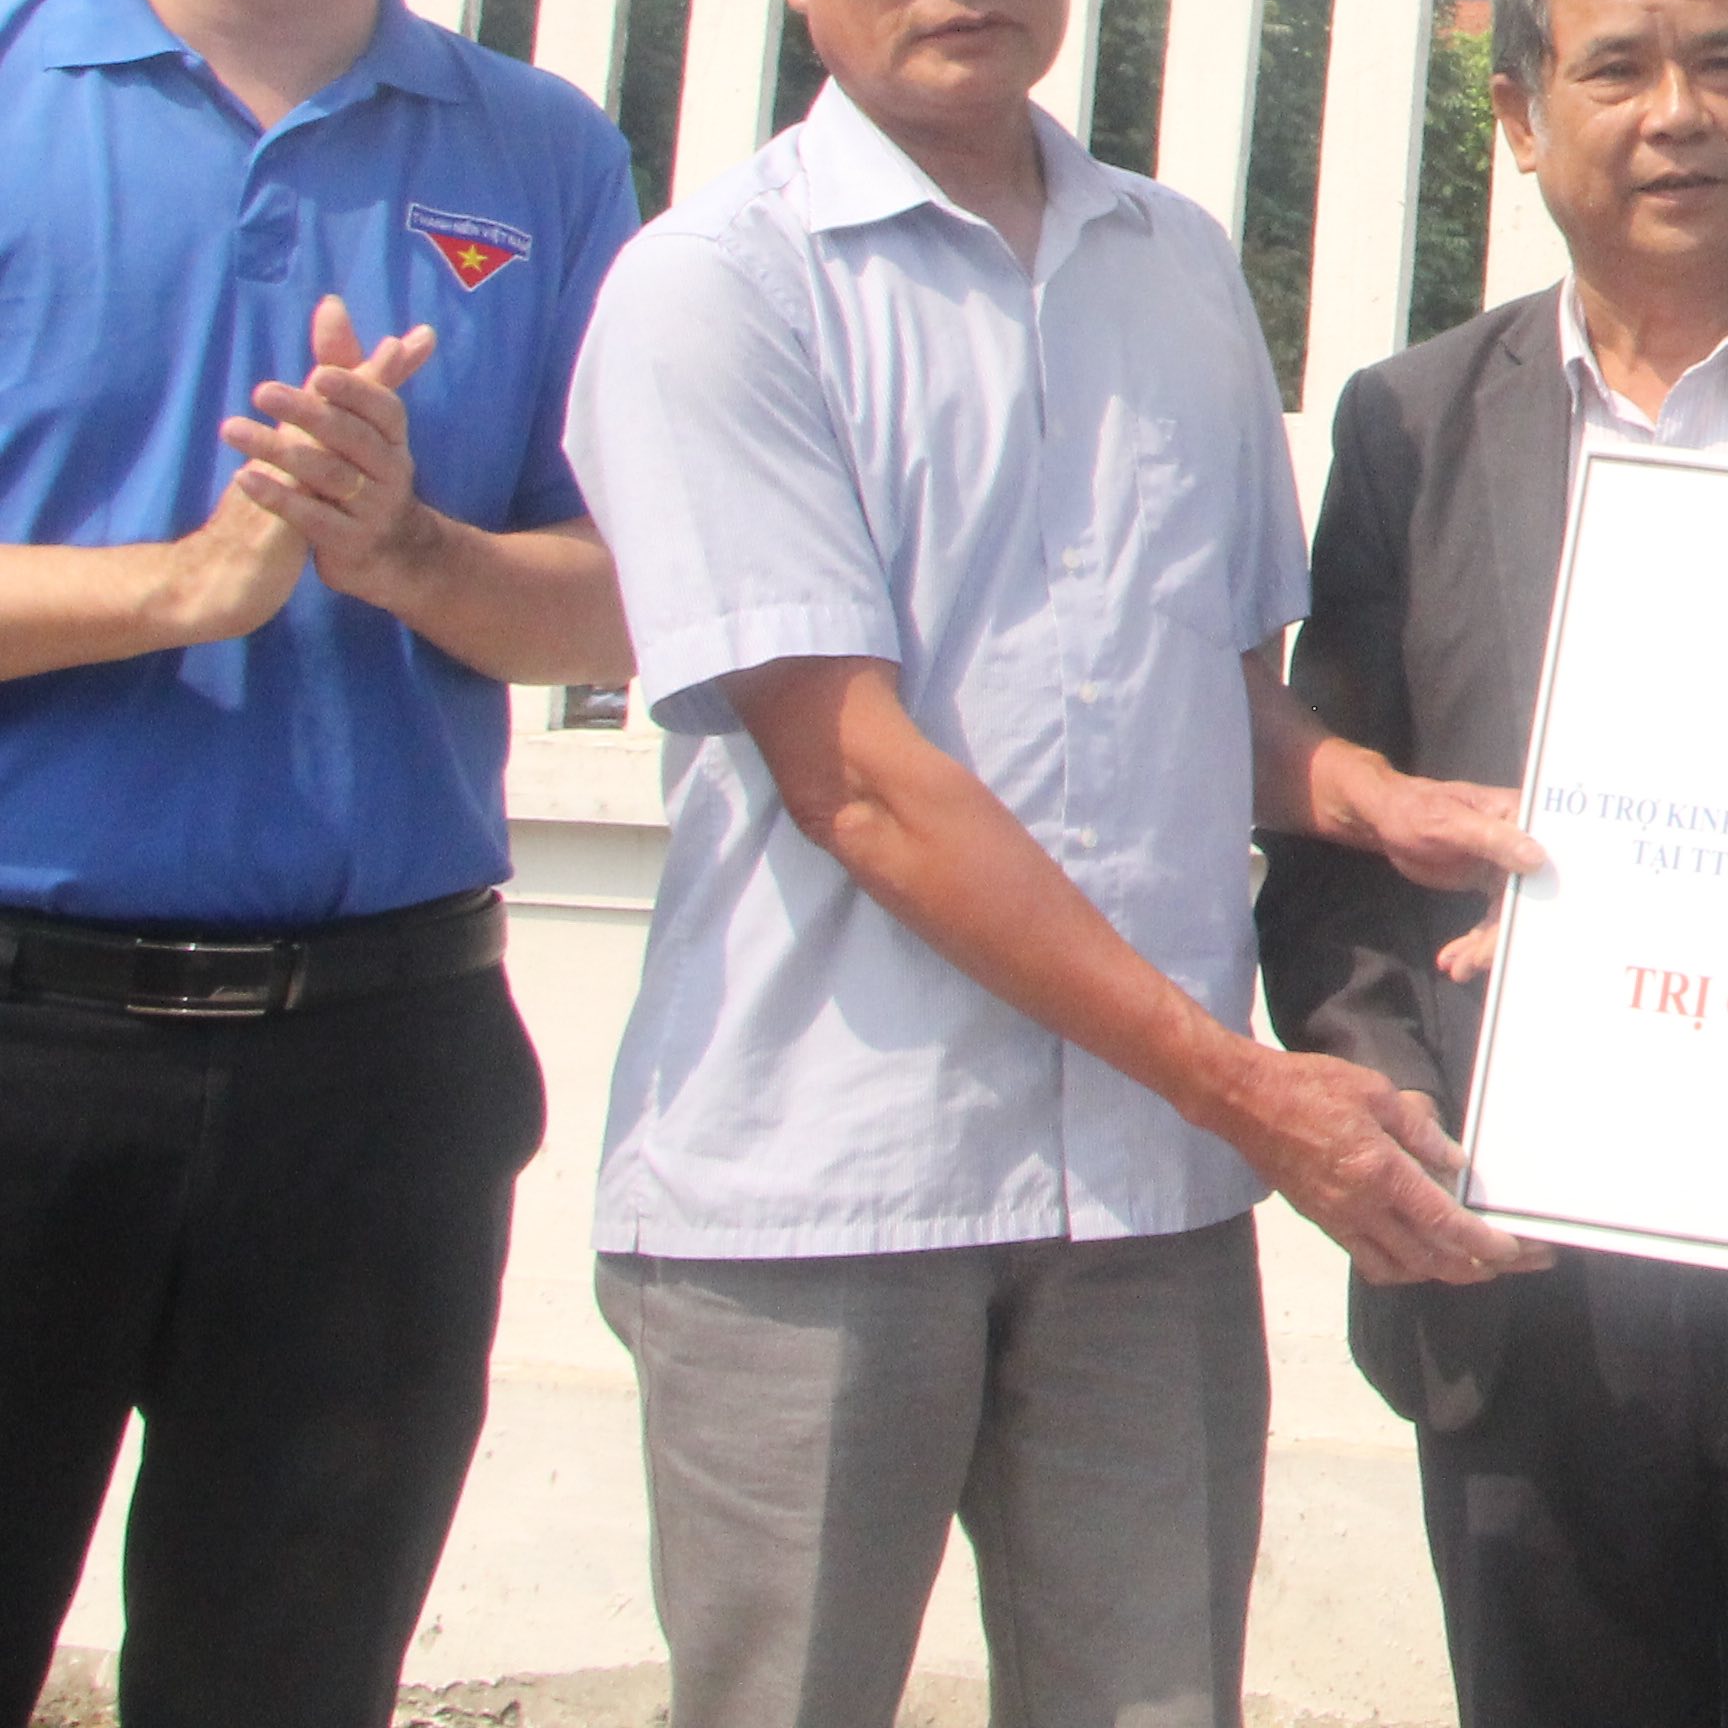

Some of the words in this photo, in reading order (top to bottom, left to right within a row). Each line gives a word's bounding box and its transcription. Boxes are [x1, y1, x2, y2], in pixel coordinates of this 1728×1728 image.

[1597, 793, 1660, 832] TRỢ
[1632, 838, 1682, 875] TẠI
[1624, 964, 1714, 1032] TRỊ
